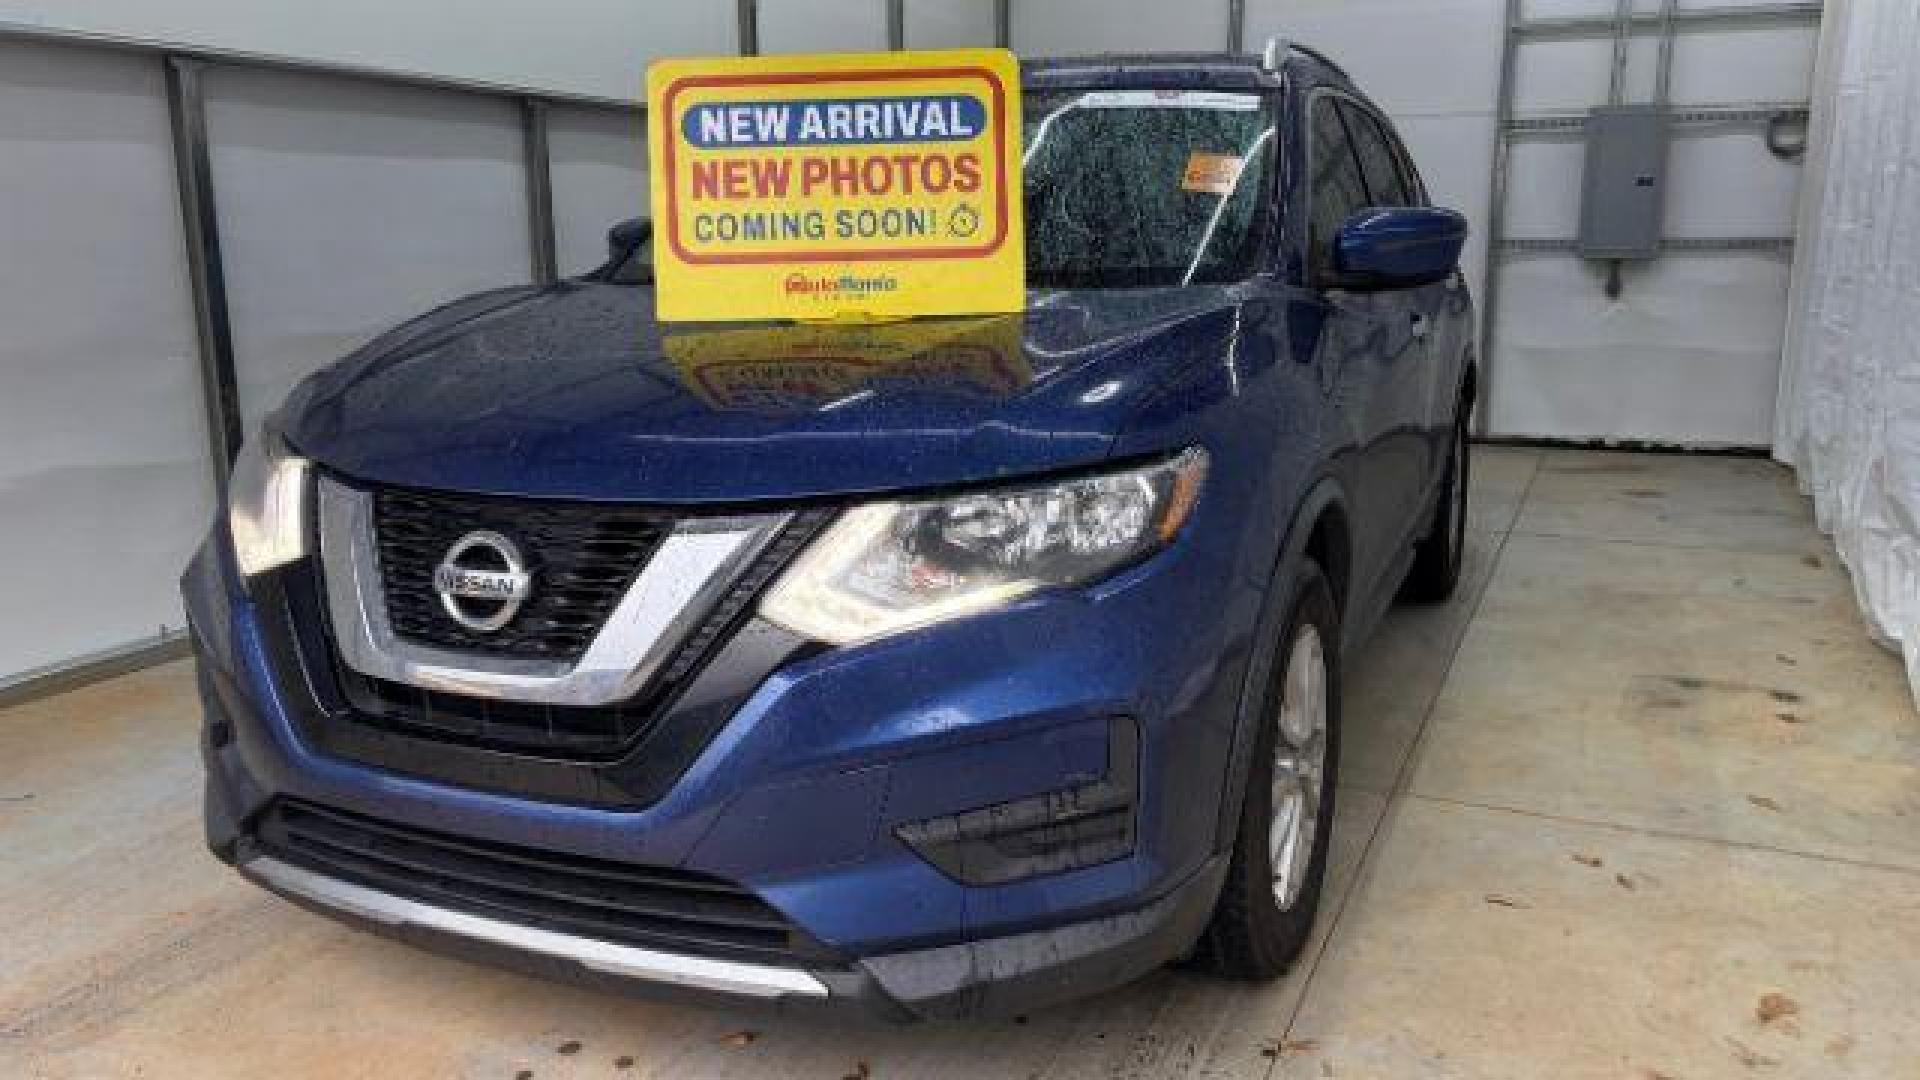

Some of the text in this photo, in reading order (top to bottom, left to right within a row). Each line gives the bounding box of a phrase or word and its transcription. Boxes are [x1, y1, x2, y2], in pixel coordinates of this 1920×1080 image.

[701, 101, 972, 142] NEW ARRIVAL
[692, 153, 981, 199] NEW PHOTOS
[695, 208, 936, 241] COMING SOON!
[440, 571, 514, 595] NISSAN
